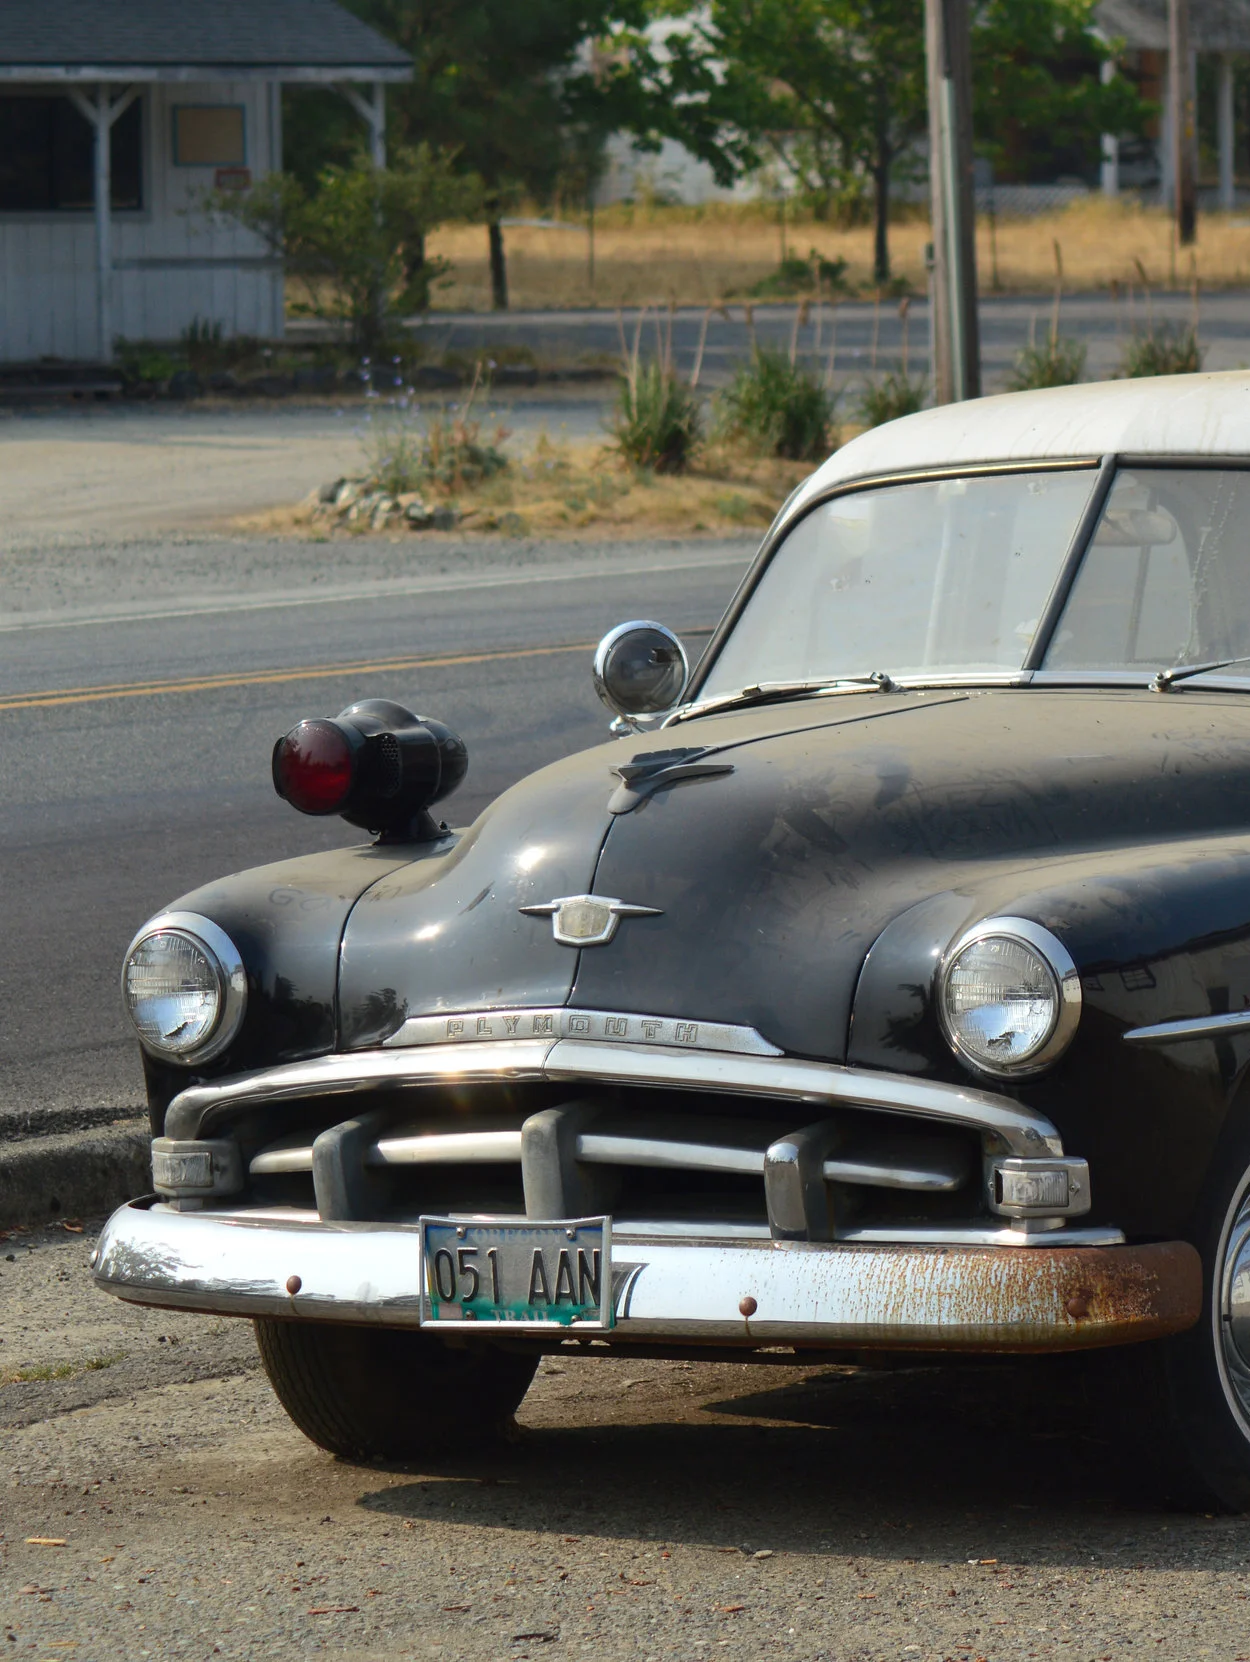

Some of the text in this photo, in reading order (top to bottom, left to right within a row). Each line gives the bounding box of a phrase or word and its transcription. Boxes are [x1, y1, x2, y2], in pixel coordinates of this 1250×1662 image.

[447, 1014, 698, 1043] PLYMOUTH
[434, 1247, 601, 1306] 051 AAN
